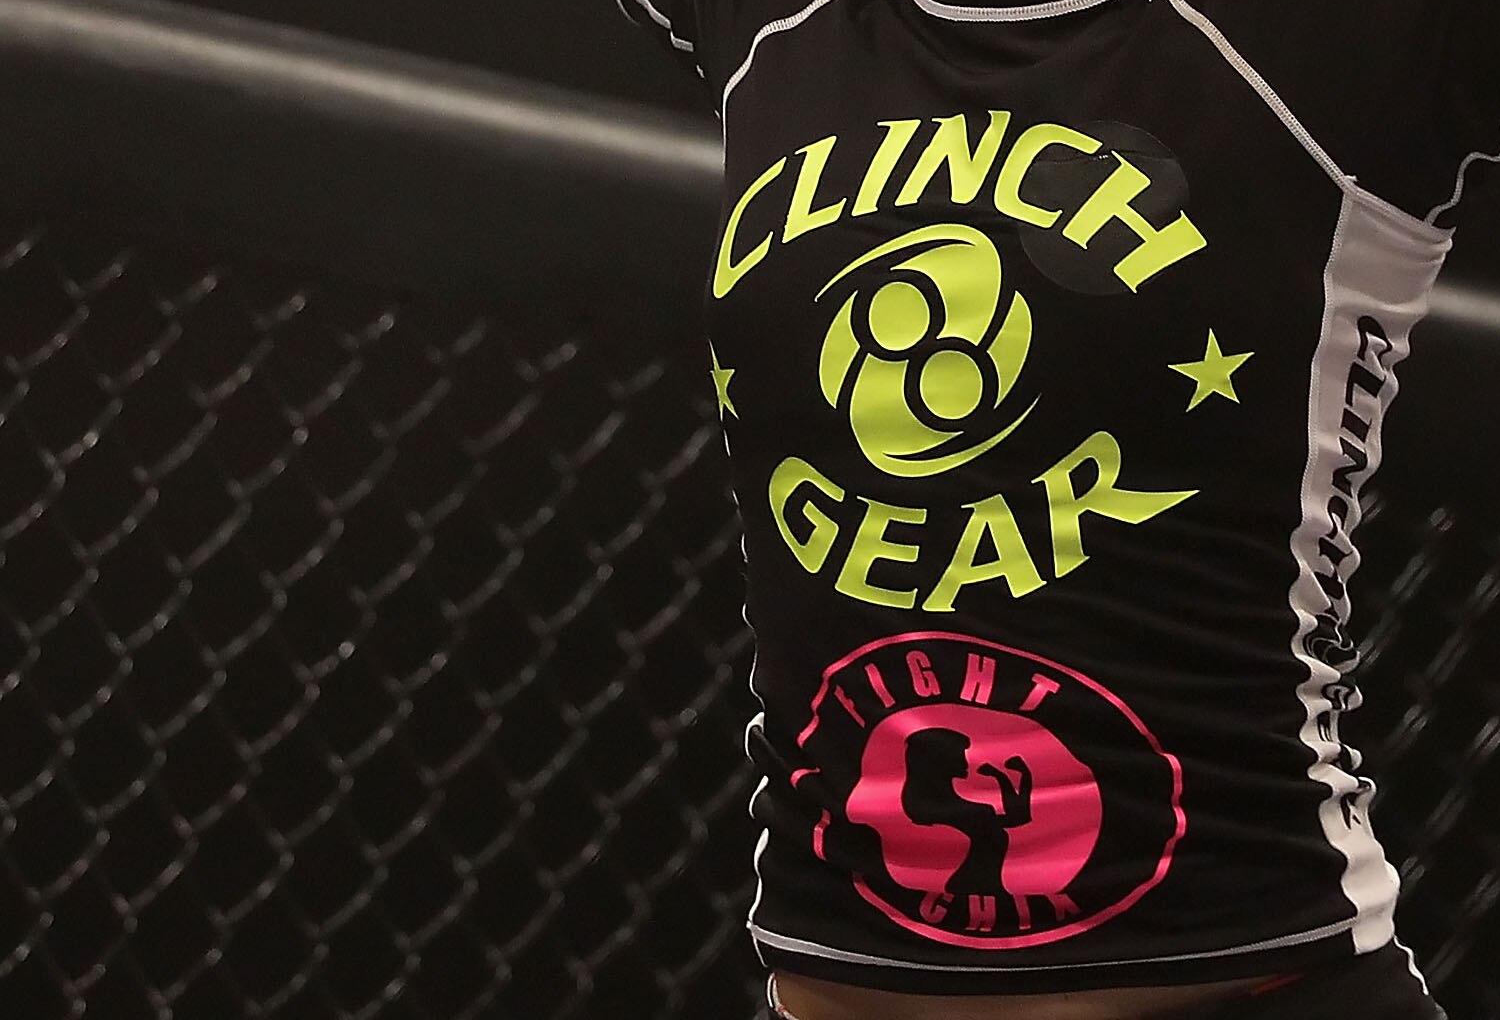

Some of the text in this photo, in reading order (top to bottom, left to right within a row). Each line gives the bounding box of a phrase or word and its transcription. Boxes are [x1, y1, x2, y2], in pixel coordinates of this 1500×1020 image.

[713, 110, 1207, 298] CLINCH
[768, 430, 1200, 612] GEAR
[834, 650, 1061, 728] FIGHT
